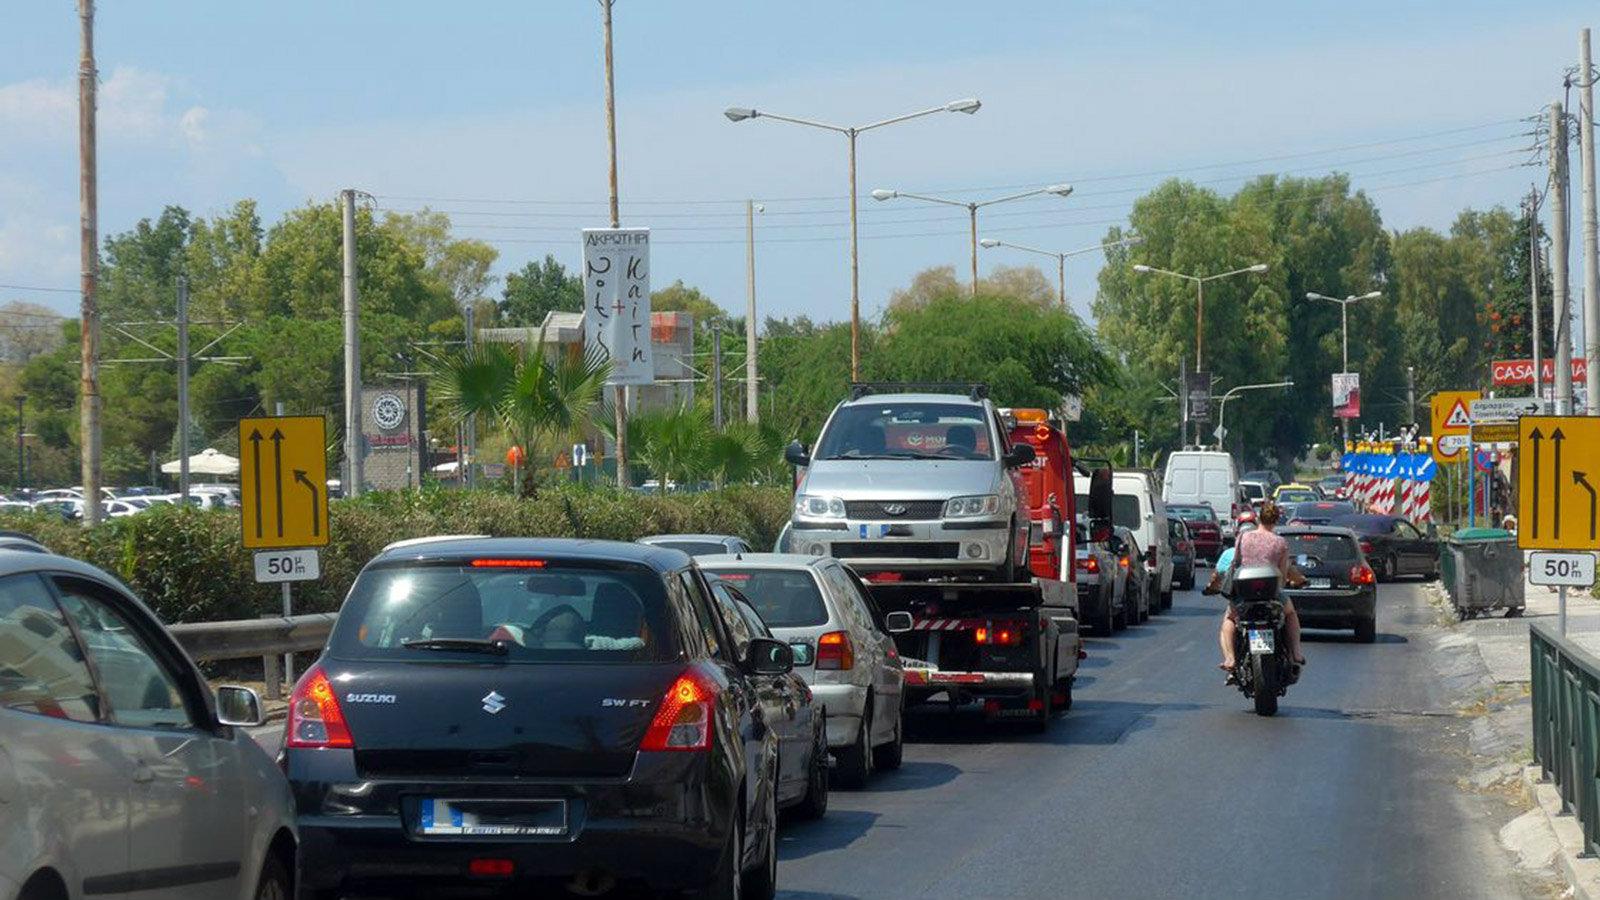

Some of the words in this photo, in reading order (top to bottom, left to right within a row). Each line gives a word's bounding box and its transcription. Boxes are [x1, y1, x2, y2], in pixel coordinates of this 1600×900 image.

[268, 557, 293, 575] 50
[1544, 560, 1570, 577] 50
[346, 693, 396, 704] SUZUKI
